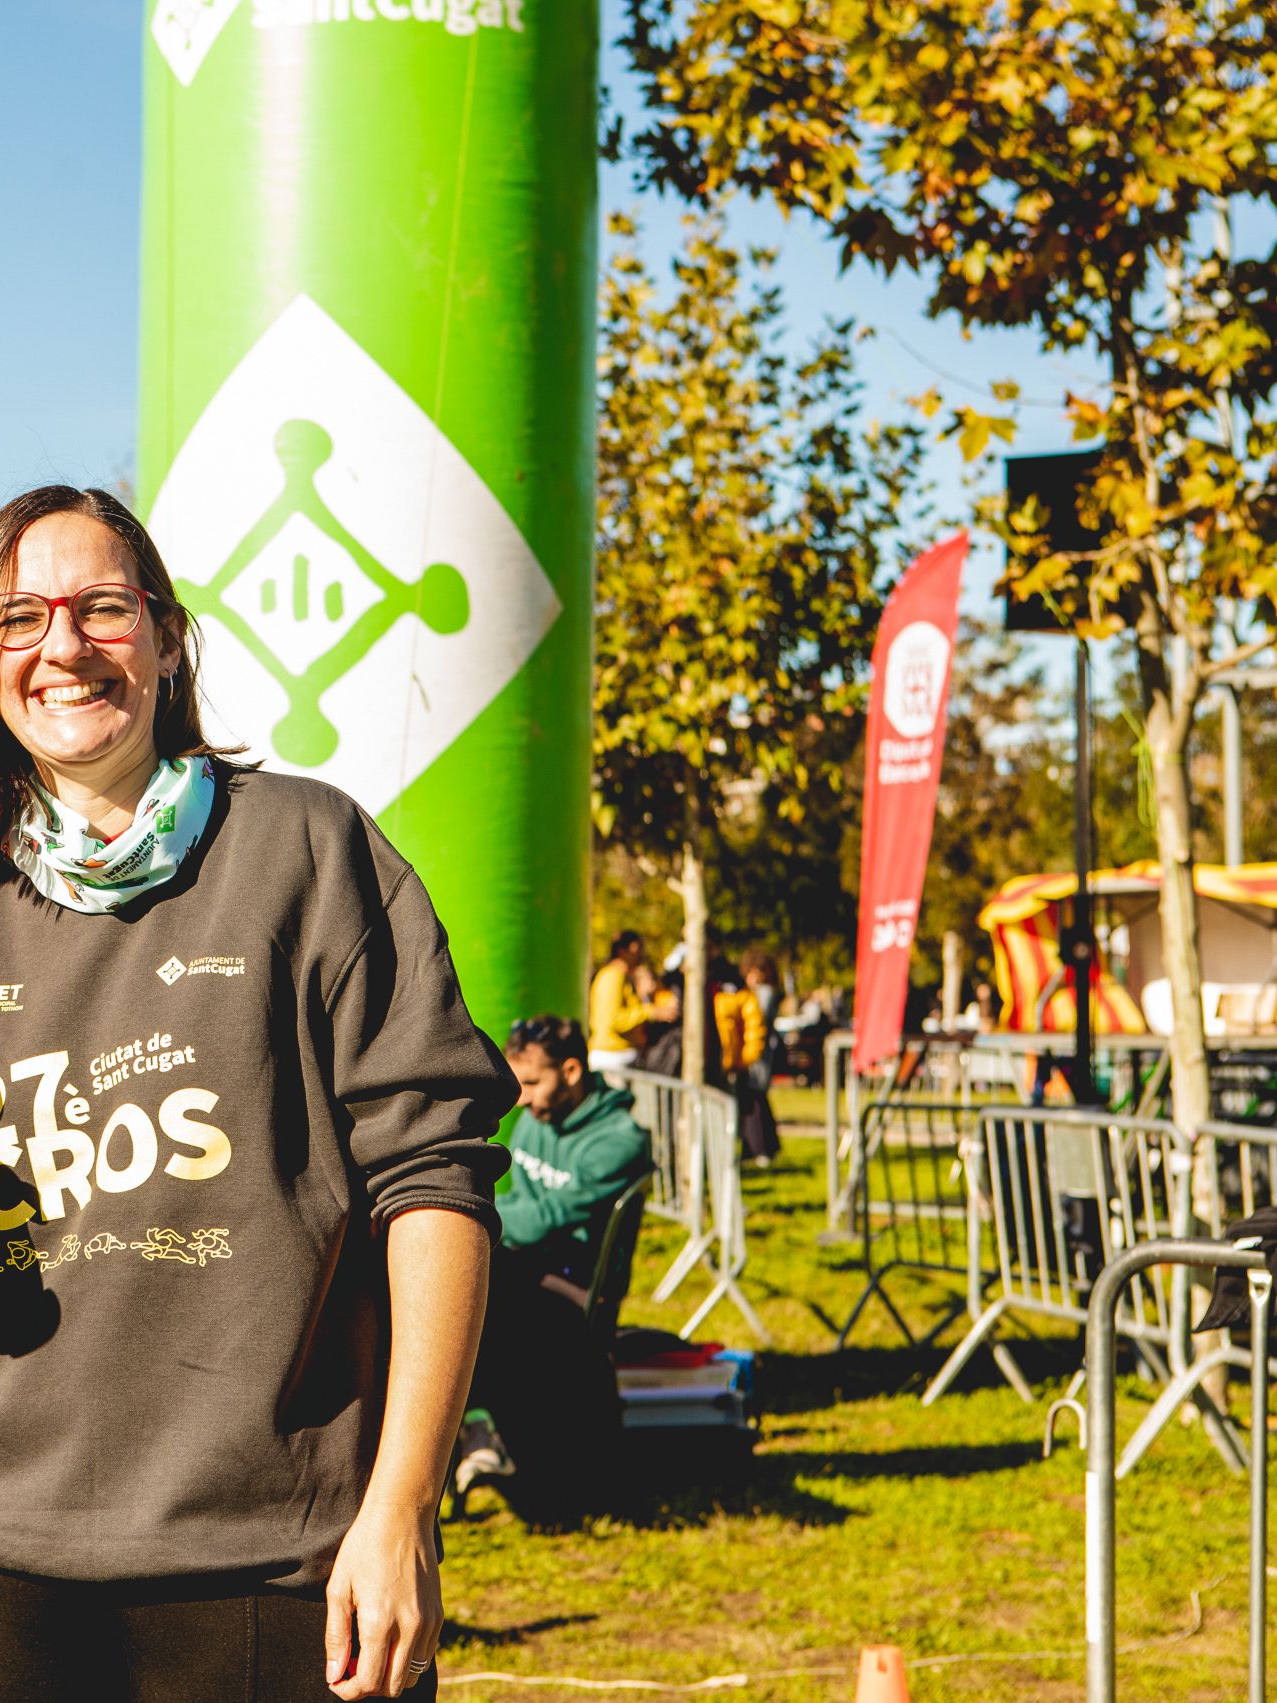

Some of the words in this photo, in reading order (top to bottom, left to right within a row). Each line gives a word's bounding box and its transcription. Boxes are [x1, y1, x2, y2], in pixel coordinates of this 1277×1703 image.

[102, 831, 155, 879] SantCugat
[187, 963, 246, 977] SantCugat
[188, 956, 234, 968] AJUNTAMENT
[235, 957, 246, 965] DE
[89, 1039, 143, 1076] Ciutat
[146, 1032, 172, 1052] de
[92, 1062, 130, 1096] Sant
[133, 1045, 196, 1073] Cugat
